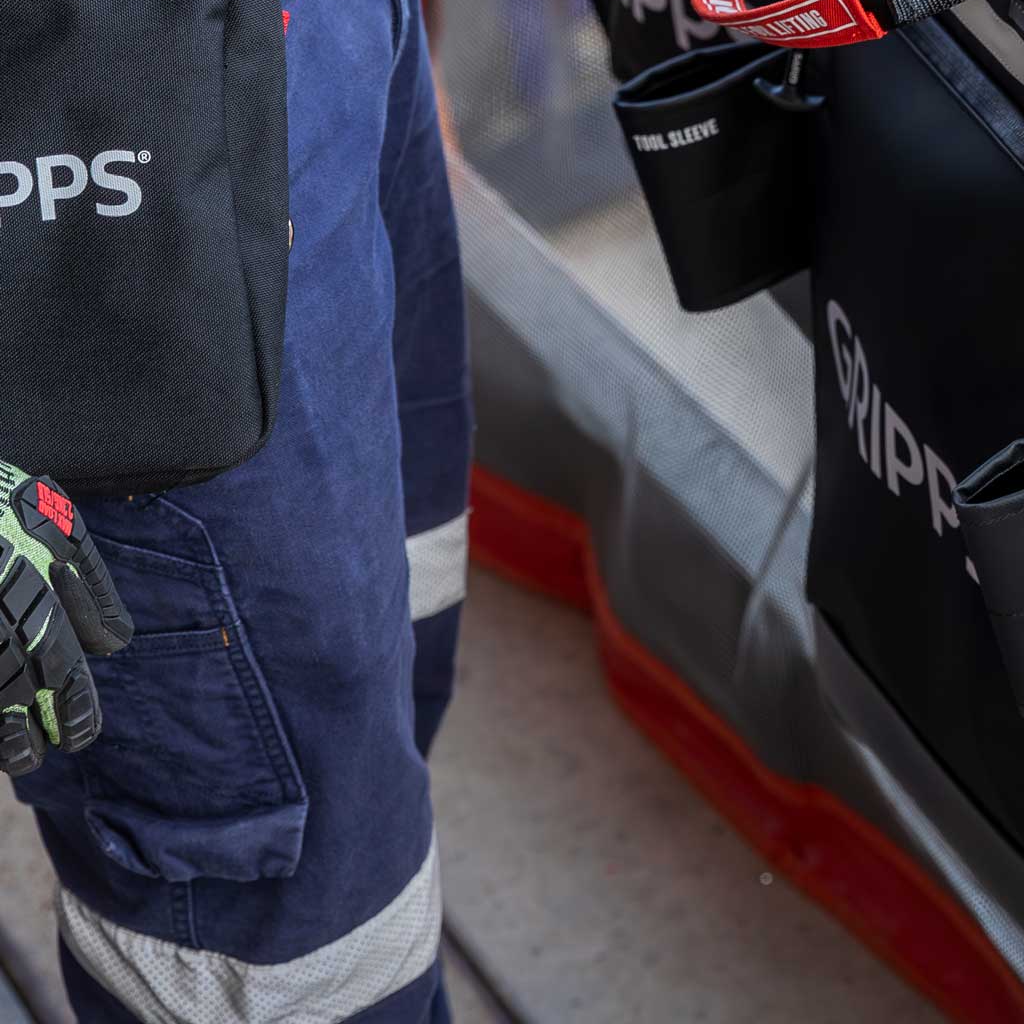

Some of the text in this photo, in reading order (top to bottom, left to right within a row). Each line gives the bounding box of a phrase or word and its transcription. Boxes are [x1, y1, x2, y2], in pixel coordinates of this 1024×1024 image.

[766, 10, 828, 35] LIFTING
[632, 117, 720, 152] TOOL SLEEVE
[826, 298, 980, 585] GRIPP
